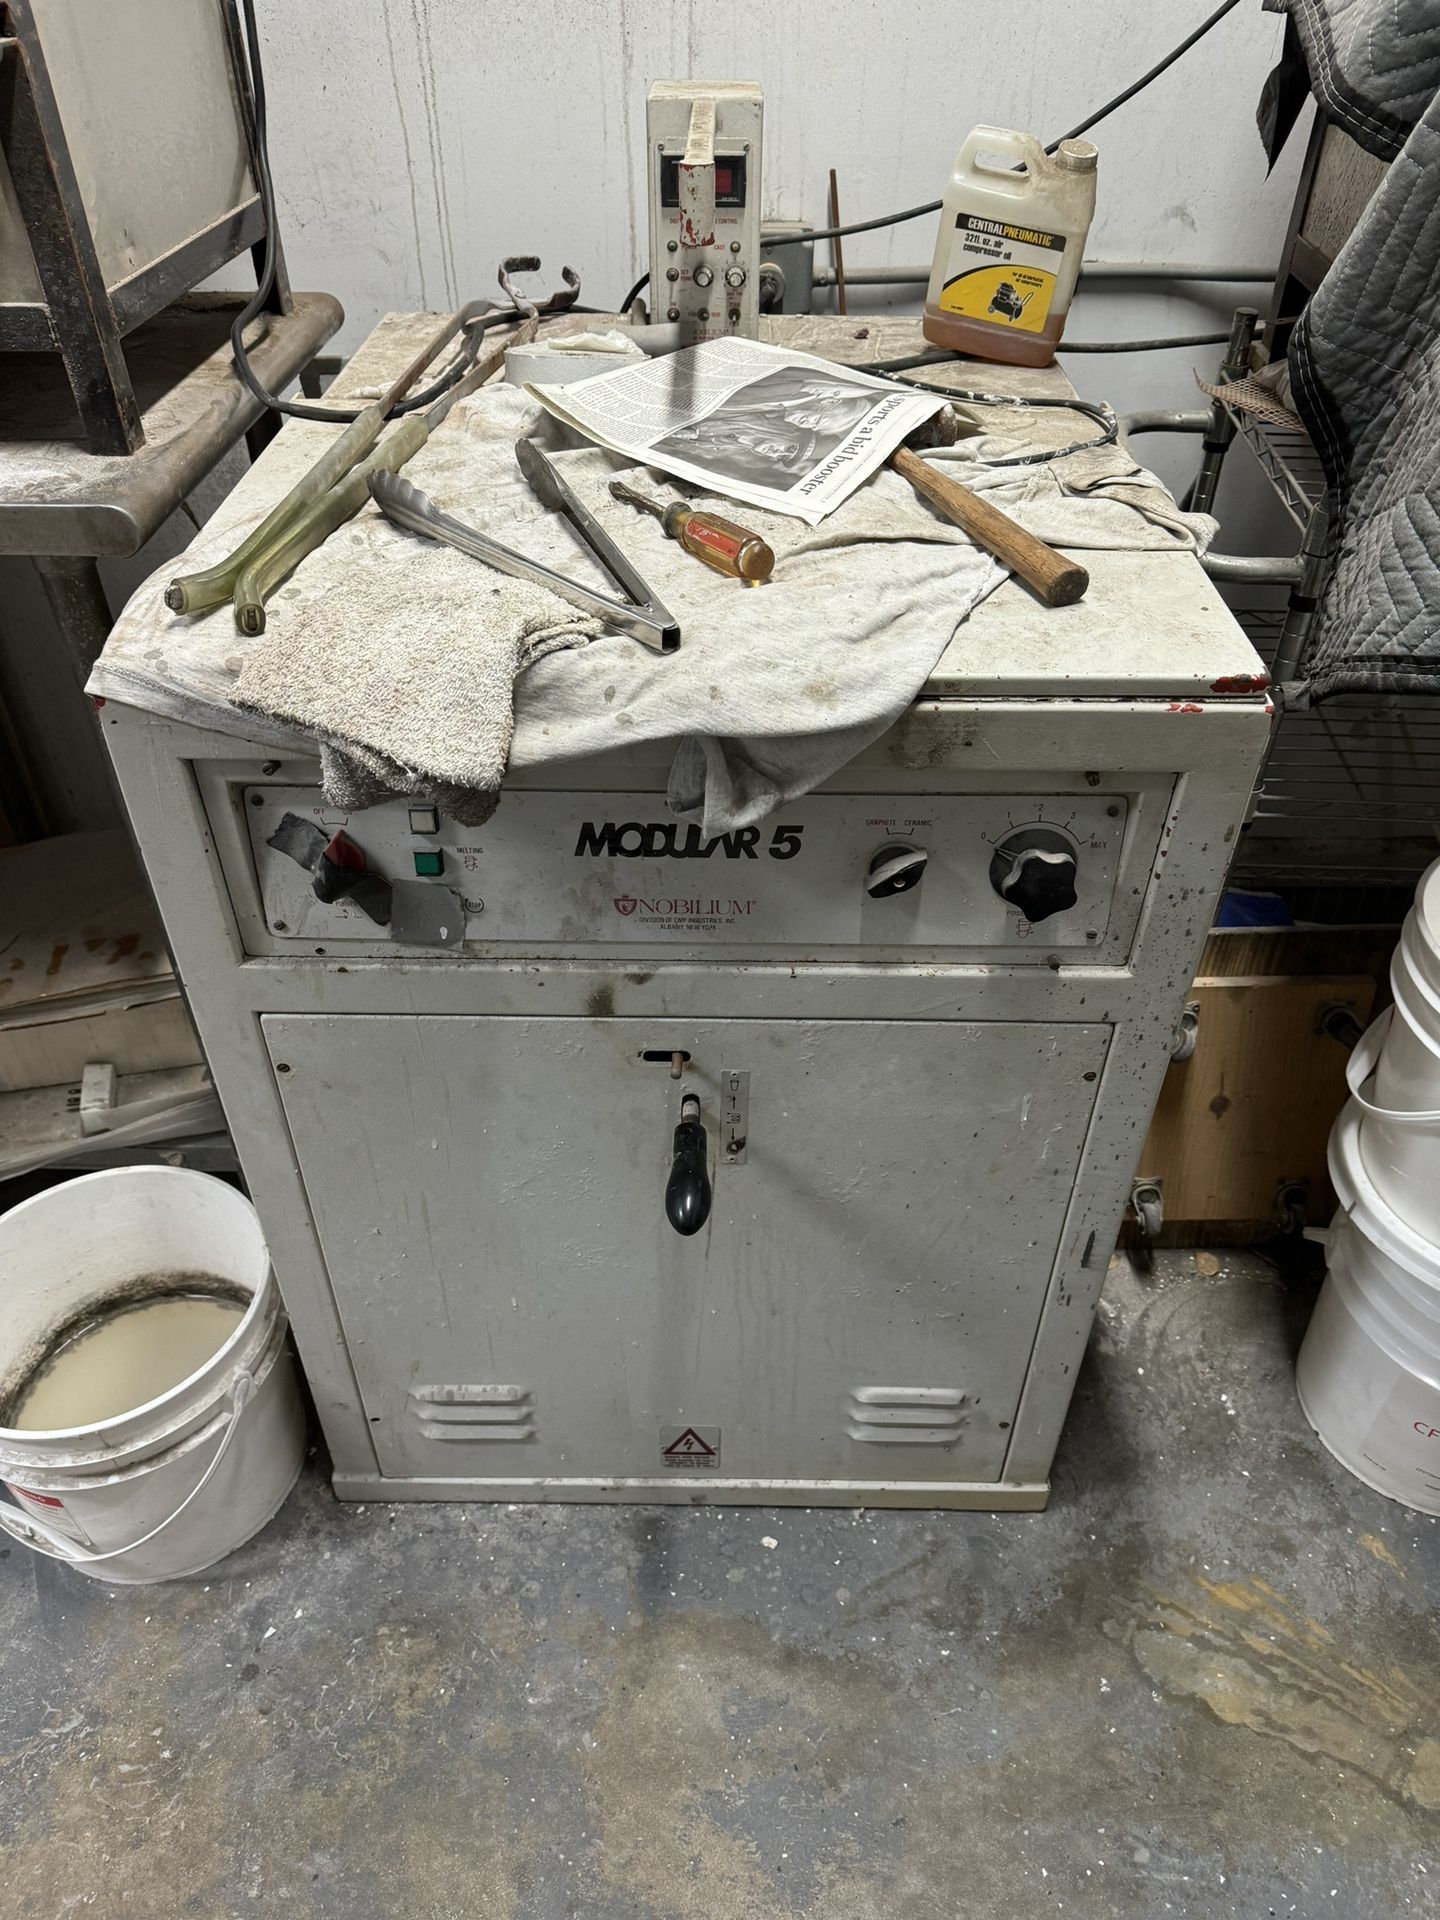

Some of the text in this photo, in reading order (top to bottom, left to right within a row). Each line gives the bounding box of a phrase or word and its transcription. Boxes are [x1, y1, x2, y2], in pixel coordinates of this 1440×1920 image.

[982, 237, 993, 247] oz.
[993, 239, 1004, 249] air
[962, 243, 1012, 260] compressor oil
[867, 394, 905, 426] sports
[859, 427, 873, 435] a
[841, 434, 872, 456] bid
[800, 454, 854, 495] booster
[313, 807, 325, 815] OFF
[1038, 803, 1044, 811] 2
[1070, 811, 1077, 819] 3
[574, 821, 804, 860] MODULAR 5
[981, 832, 987, 840] 0
[1090, 841, 1108, 849] MAX
